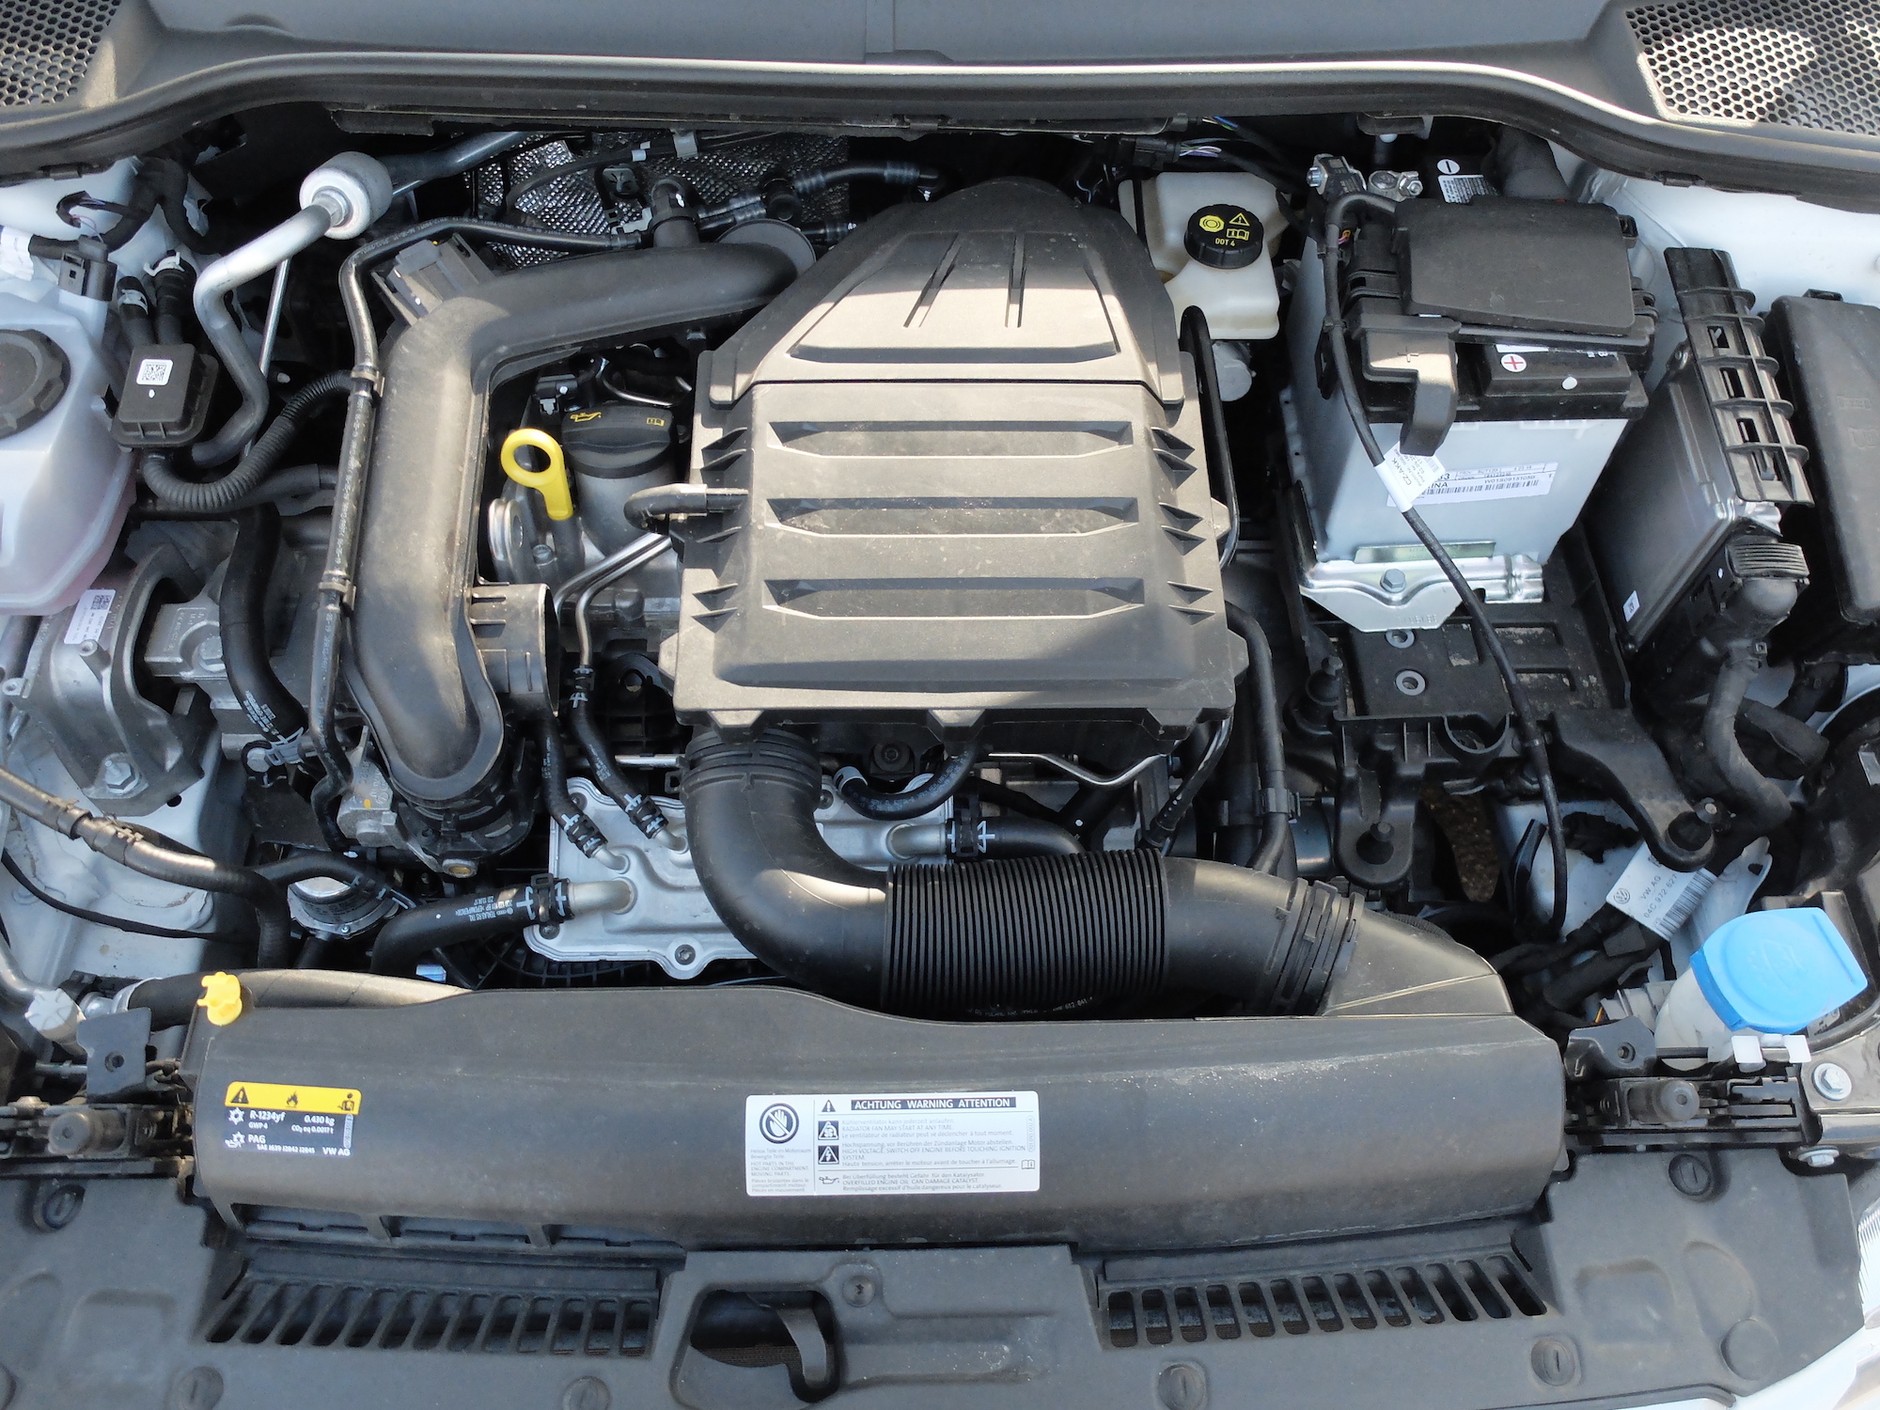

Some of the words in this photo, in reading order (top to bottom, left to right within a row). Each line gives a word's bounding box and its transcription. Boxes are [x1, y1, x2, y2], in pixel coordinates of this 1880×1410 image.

[1215, 238, 1230, 246] DOT
[1640, 887, 1652, 900] VW
[1652, 875, 1661, 887] AG
[854, 1100, 902, 1109] ACHTUNG
[906, 1099, 954, 1108] WARNING
[958, 1098, 1010, 1108] ATTENTION
[249, 1110, 286, 1123] R-1234yf
[325, 1116, 335, 1126] kg
[248, 1134, 266, 1144] PAG
[322, 1146, 337, 1155] VW
[338, 1148, 350, 1156] AG
